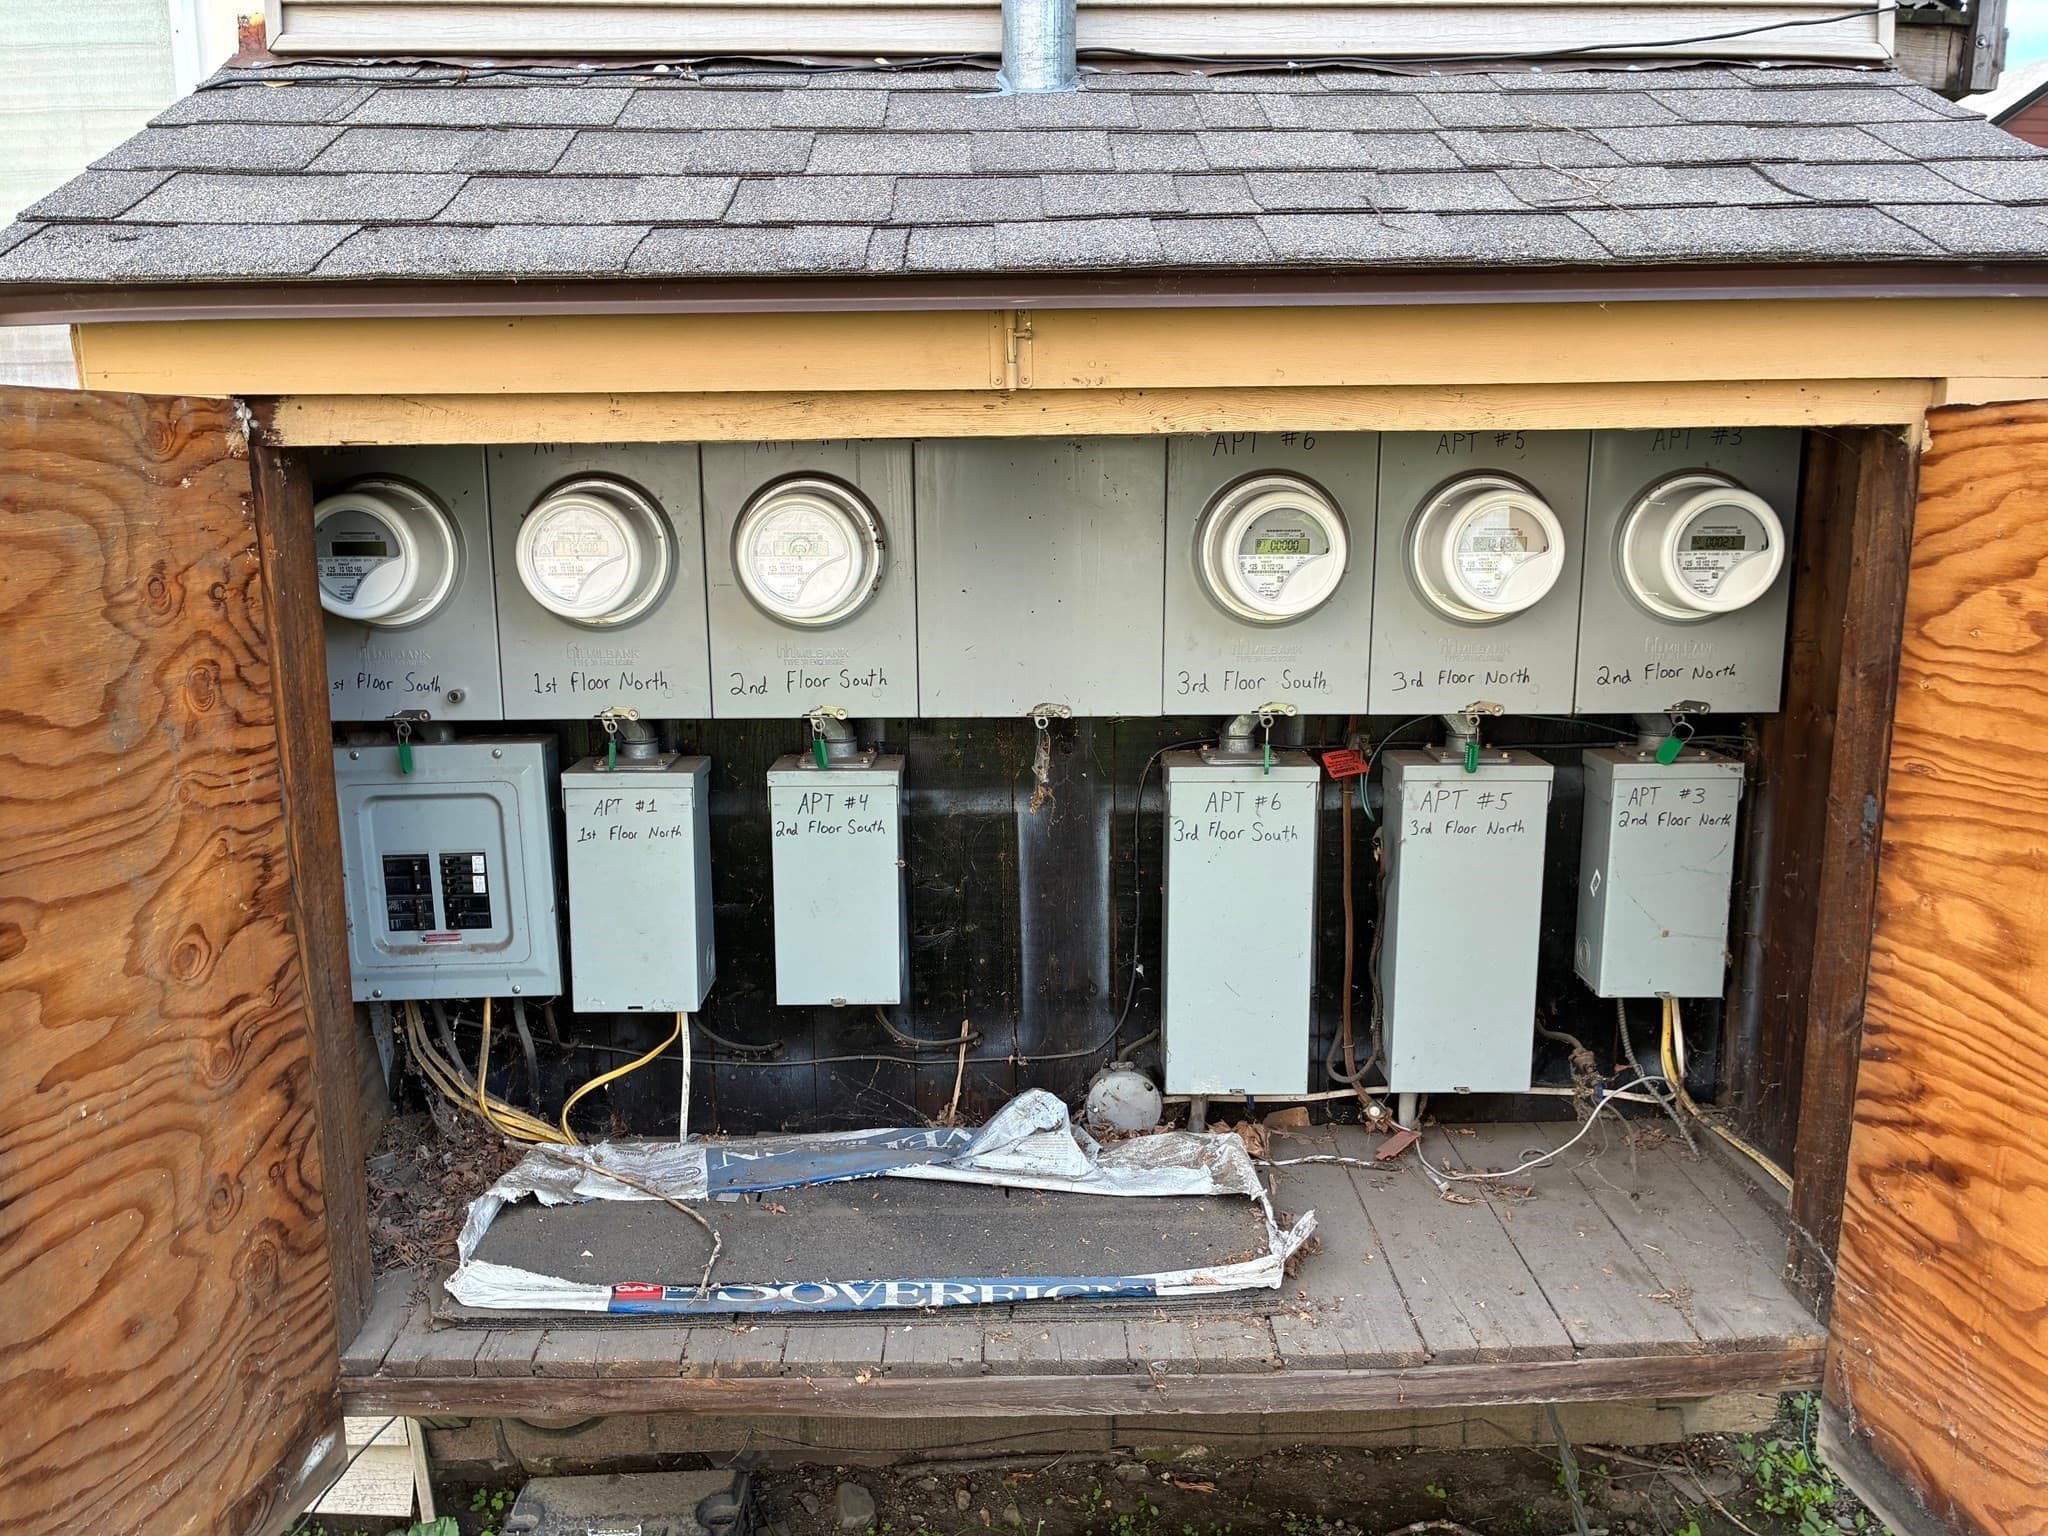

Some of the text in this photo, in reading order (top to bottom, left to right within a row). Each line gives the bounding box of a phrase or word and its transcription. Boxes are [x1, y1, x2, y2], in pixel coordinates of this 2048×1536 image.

[1212, 431, 1316, 456] APT #6
[1436, 431, 1527, 454] APT #5
[332, 671, 441, 693] st Floor South
[534, 670, 669, 693] 1st Floor North
[730, 667, 888, 696] 2nd Floor South
[1176, 669, 1327, 695] 3rd Floor South
[1391, 667, 1530, 691] 3rd Floor North
[1596, 662, 1736, 685] 2nd Floor North
[593, 798, 658, 816] APT #1
[797, 792, 869, 815] APT #4
[1205, 791, 1281, 813] APT #6
[1420, 789, 1513, 813] APT #5
[1628, 786, 1706, 807] APT #3
[775, 818, 886, 837] 2nd Floor South
[1173, 819, 1298, 842] 3rd Floor South
[1410, 819, 1525, 836] 3rd Floor North
[1618, 811, 1732, 827] 2nd Floor North
[577, 825, 682, 842] 1st Floor North
